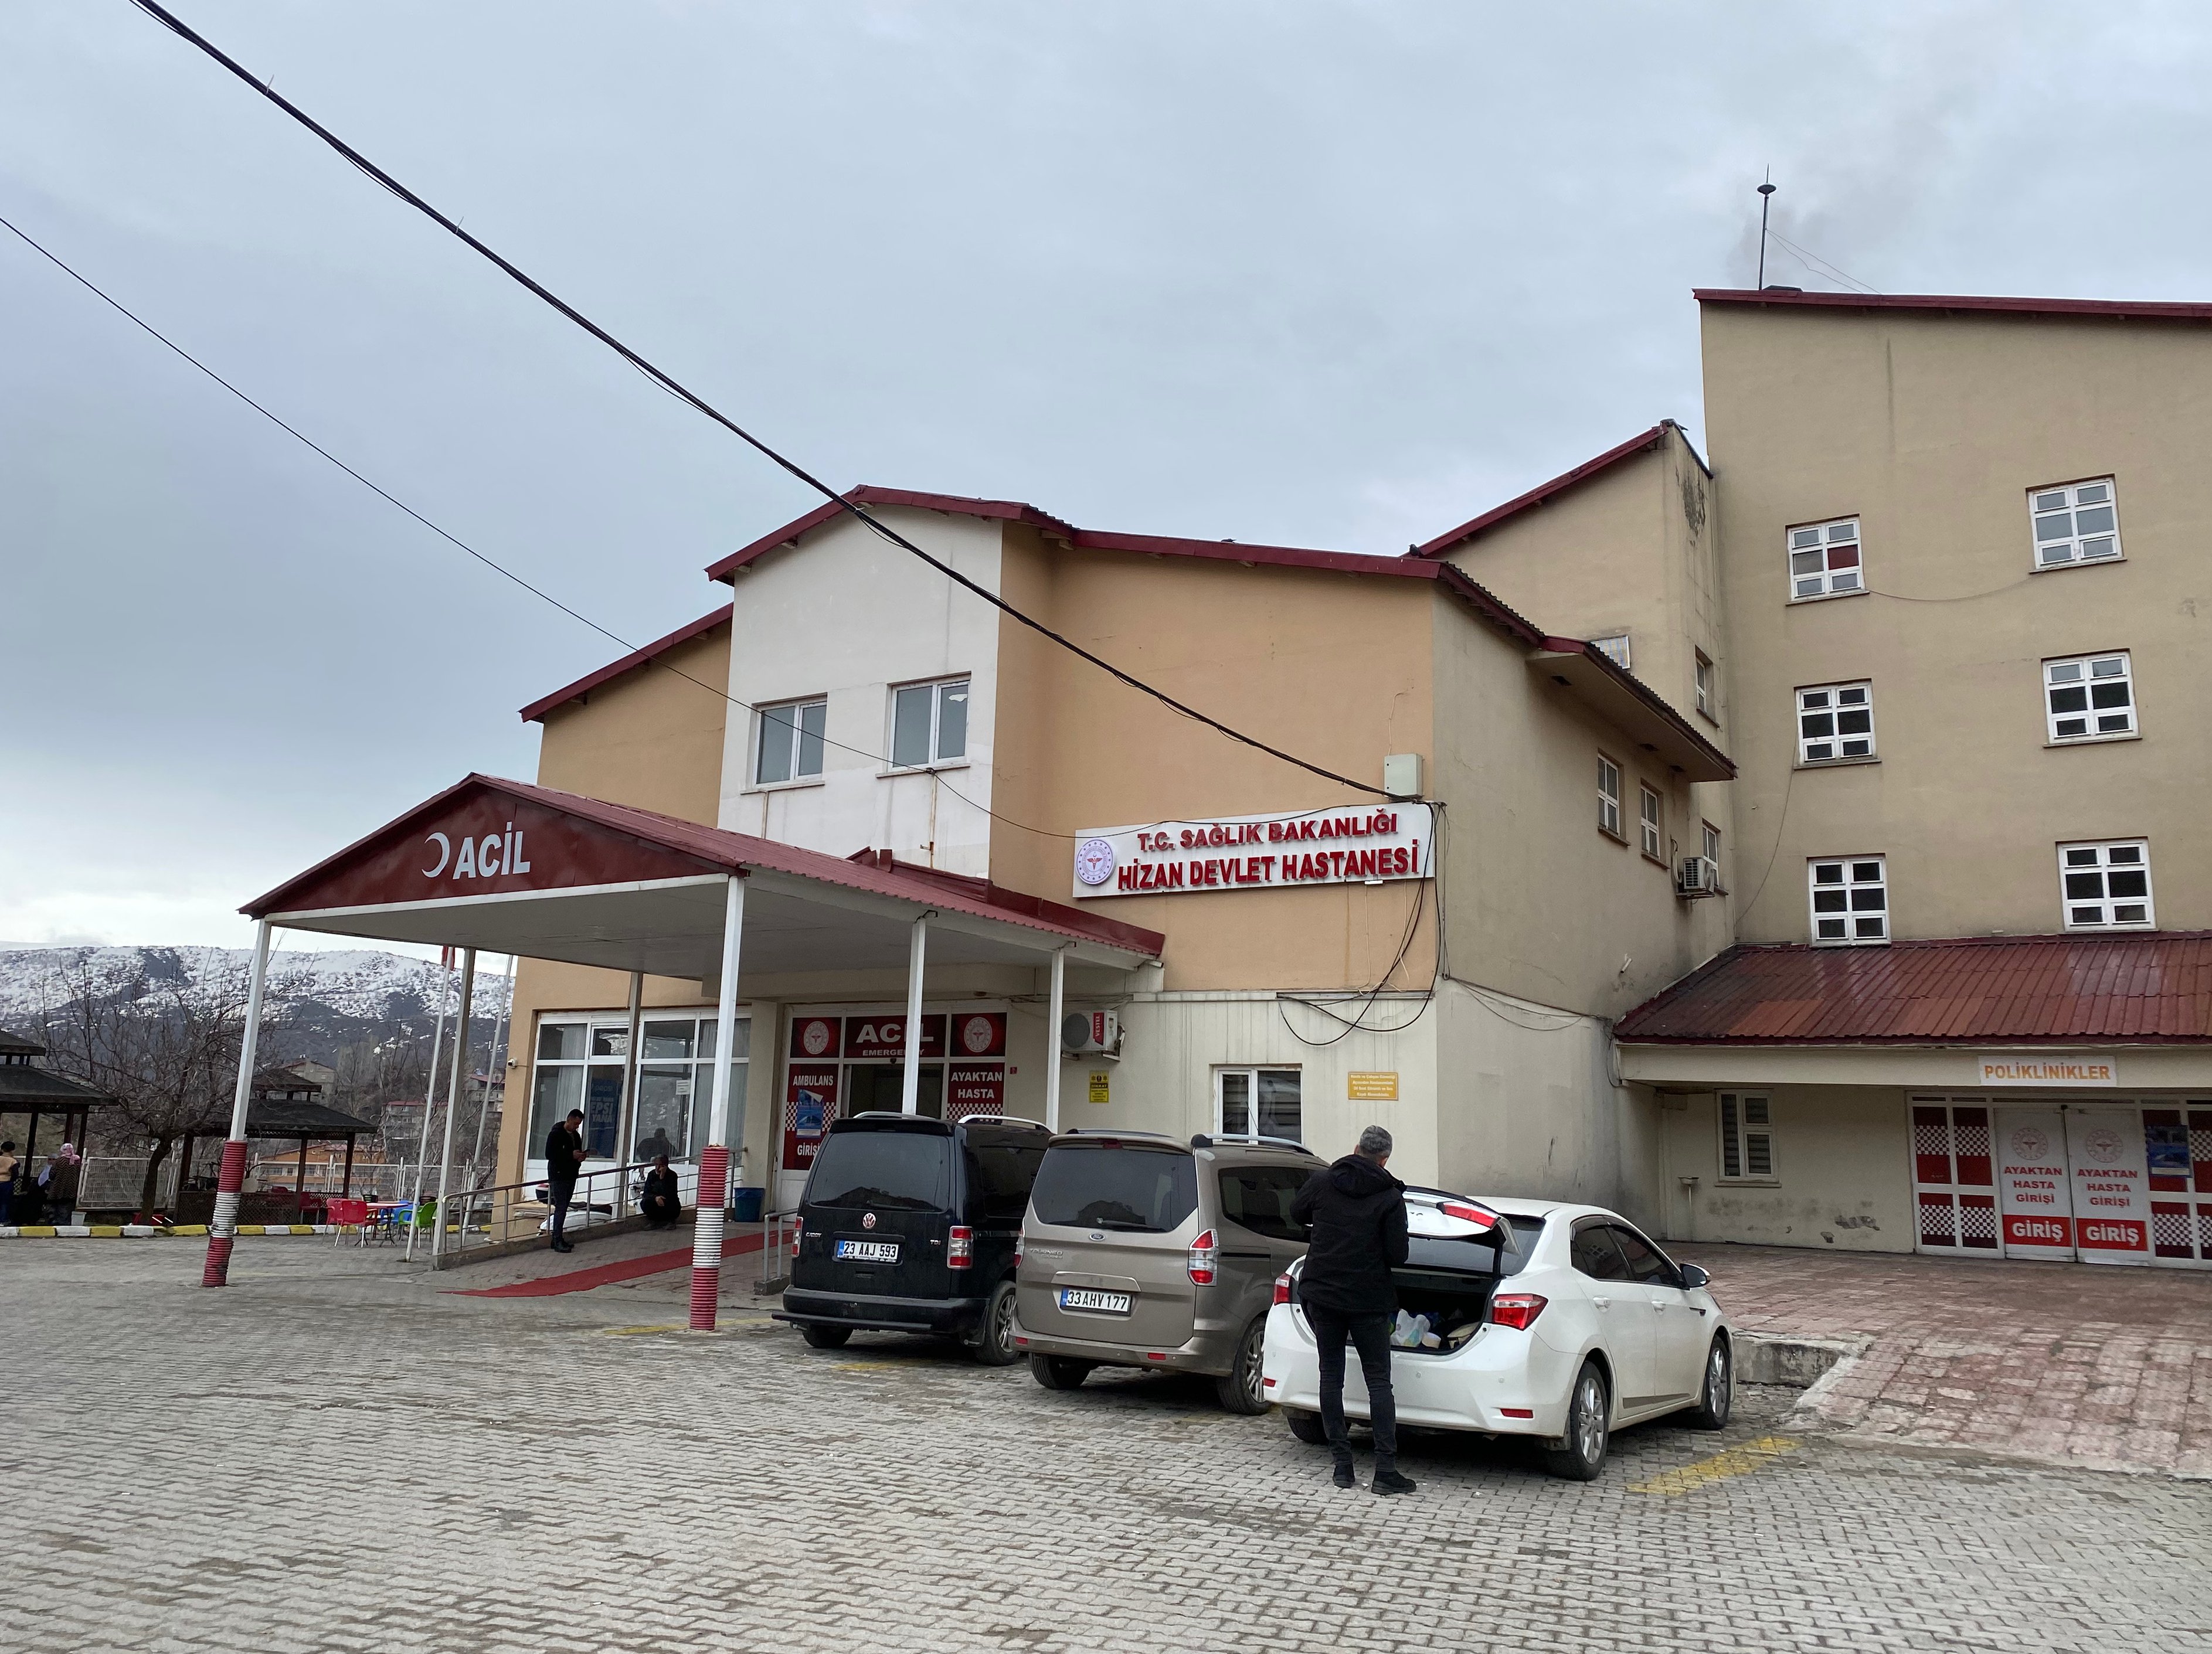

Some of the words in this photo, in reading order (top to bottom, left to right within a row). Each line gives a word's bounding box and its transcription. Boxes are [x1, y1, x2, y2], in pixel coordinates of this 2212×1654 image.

[1137, 832, 1175, 852] T.C.
[1180, 823, 1263, 848] SAĞLIK
[1269, 808, 1398, 842] BAKANLIĞI
[453, 821, 531, 880] ACİL
[1118, 858, 1184, 890] HİZAN
[1190, 856, 1276, 886] DEVLET
[1282, 839, 1419, 880] HASTANESİ
[951, 1072, 1003, 1081] AYAKTAN
[1985, 1062, 2111, 1080] POLİKLİNİKLER
[793, 1075, 834, 1086] AMBULANS
[958, 1089, 994, 1098] HASTA
[2004, 1166, 2063, 1176] AYAKTAN
[2077, 1169, 2138, 1178] AYAKTAN
[2013, 1180, 2055, 1189] HASTA
[2087, 1183, 2131, 1192] HASTA
[2016, 1192, 2055, 1204] GİRİŞİ
[2089, 1196, 2130, 1208] GİRİŞİ
[2012, 1220, 2063, 1242] GİRİŞ
[2086, 1223, 2139, 1246] GİRİŞ
[843, 1243, 855, 1254] 23
[858, 1244, 876, 1256] AAJ
[879, 1245, 896, 1258] 593
[1067, 1291, 1081, 1305] 33
[1082, 1292, 1105, 1307] AHV
[1107, 1295, 1128, 1309] 177
